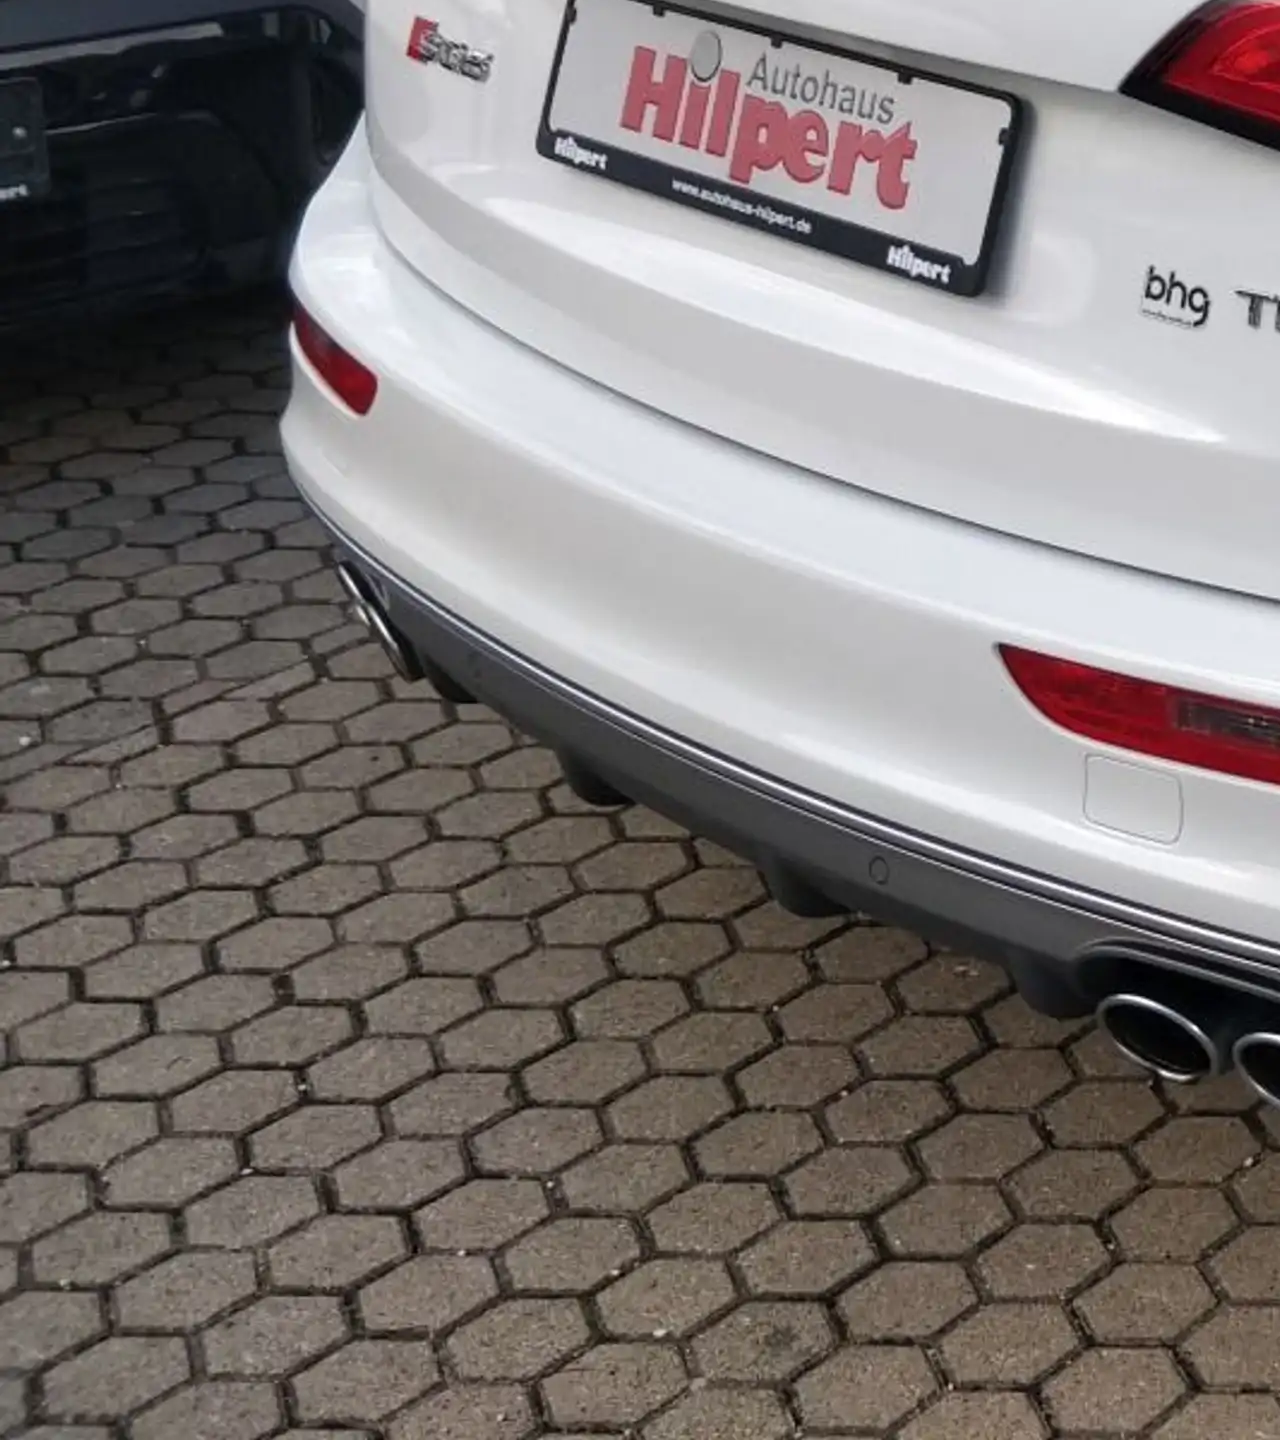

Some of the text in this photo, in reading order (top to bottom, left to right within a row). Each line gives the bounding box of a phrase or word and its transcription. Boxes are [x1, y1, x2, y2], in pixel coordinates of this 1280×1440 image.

[745, 53, 895, 126] Autohaus
[619, 30, 918, 210] Hilpert
[554, 135, 608, 171] Hilpert
[672, 178, 813, 234] www.autohaus-hilpert.de
[886, 244, 951, 284] Hilpert
[1144, 264, 1211, 328] bhg
